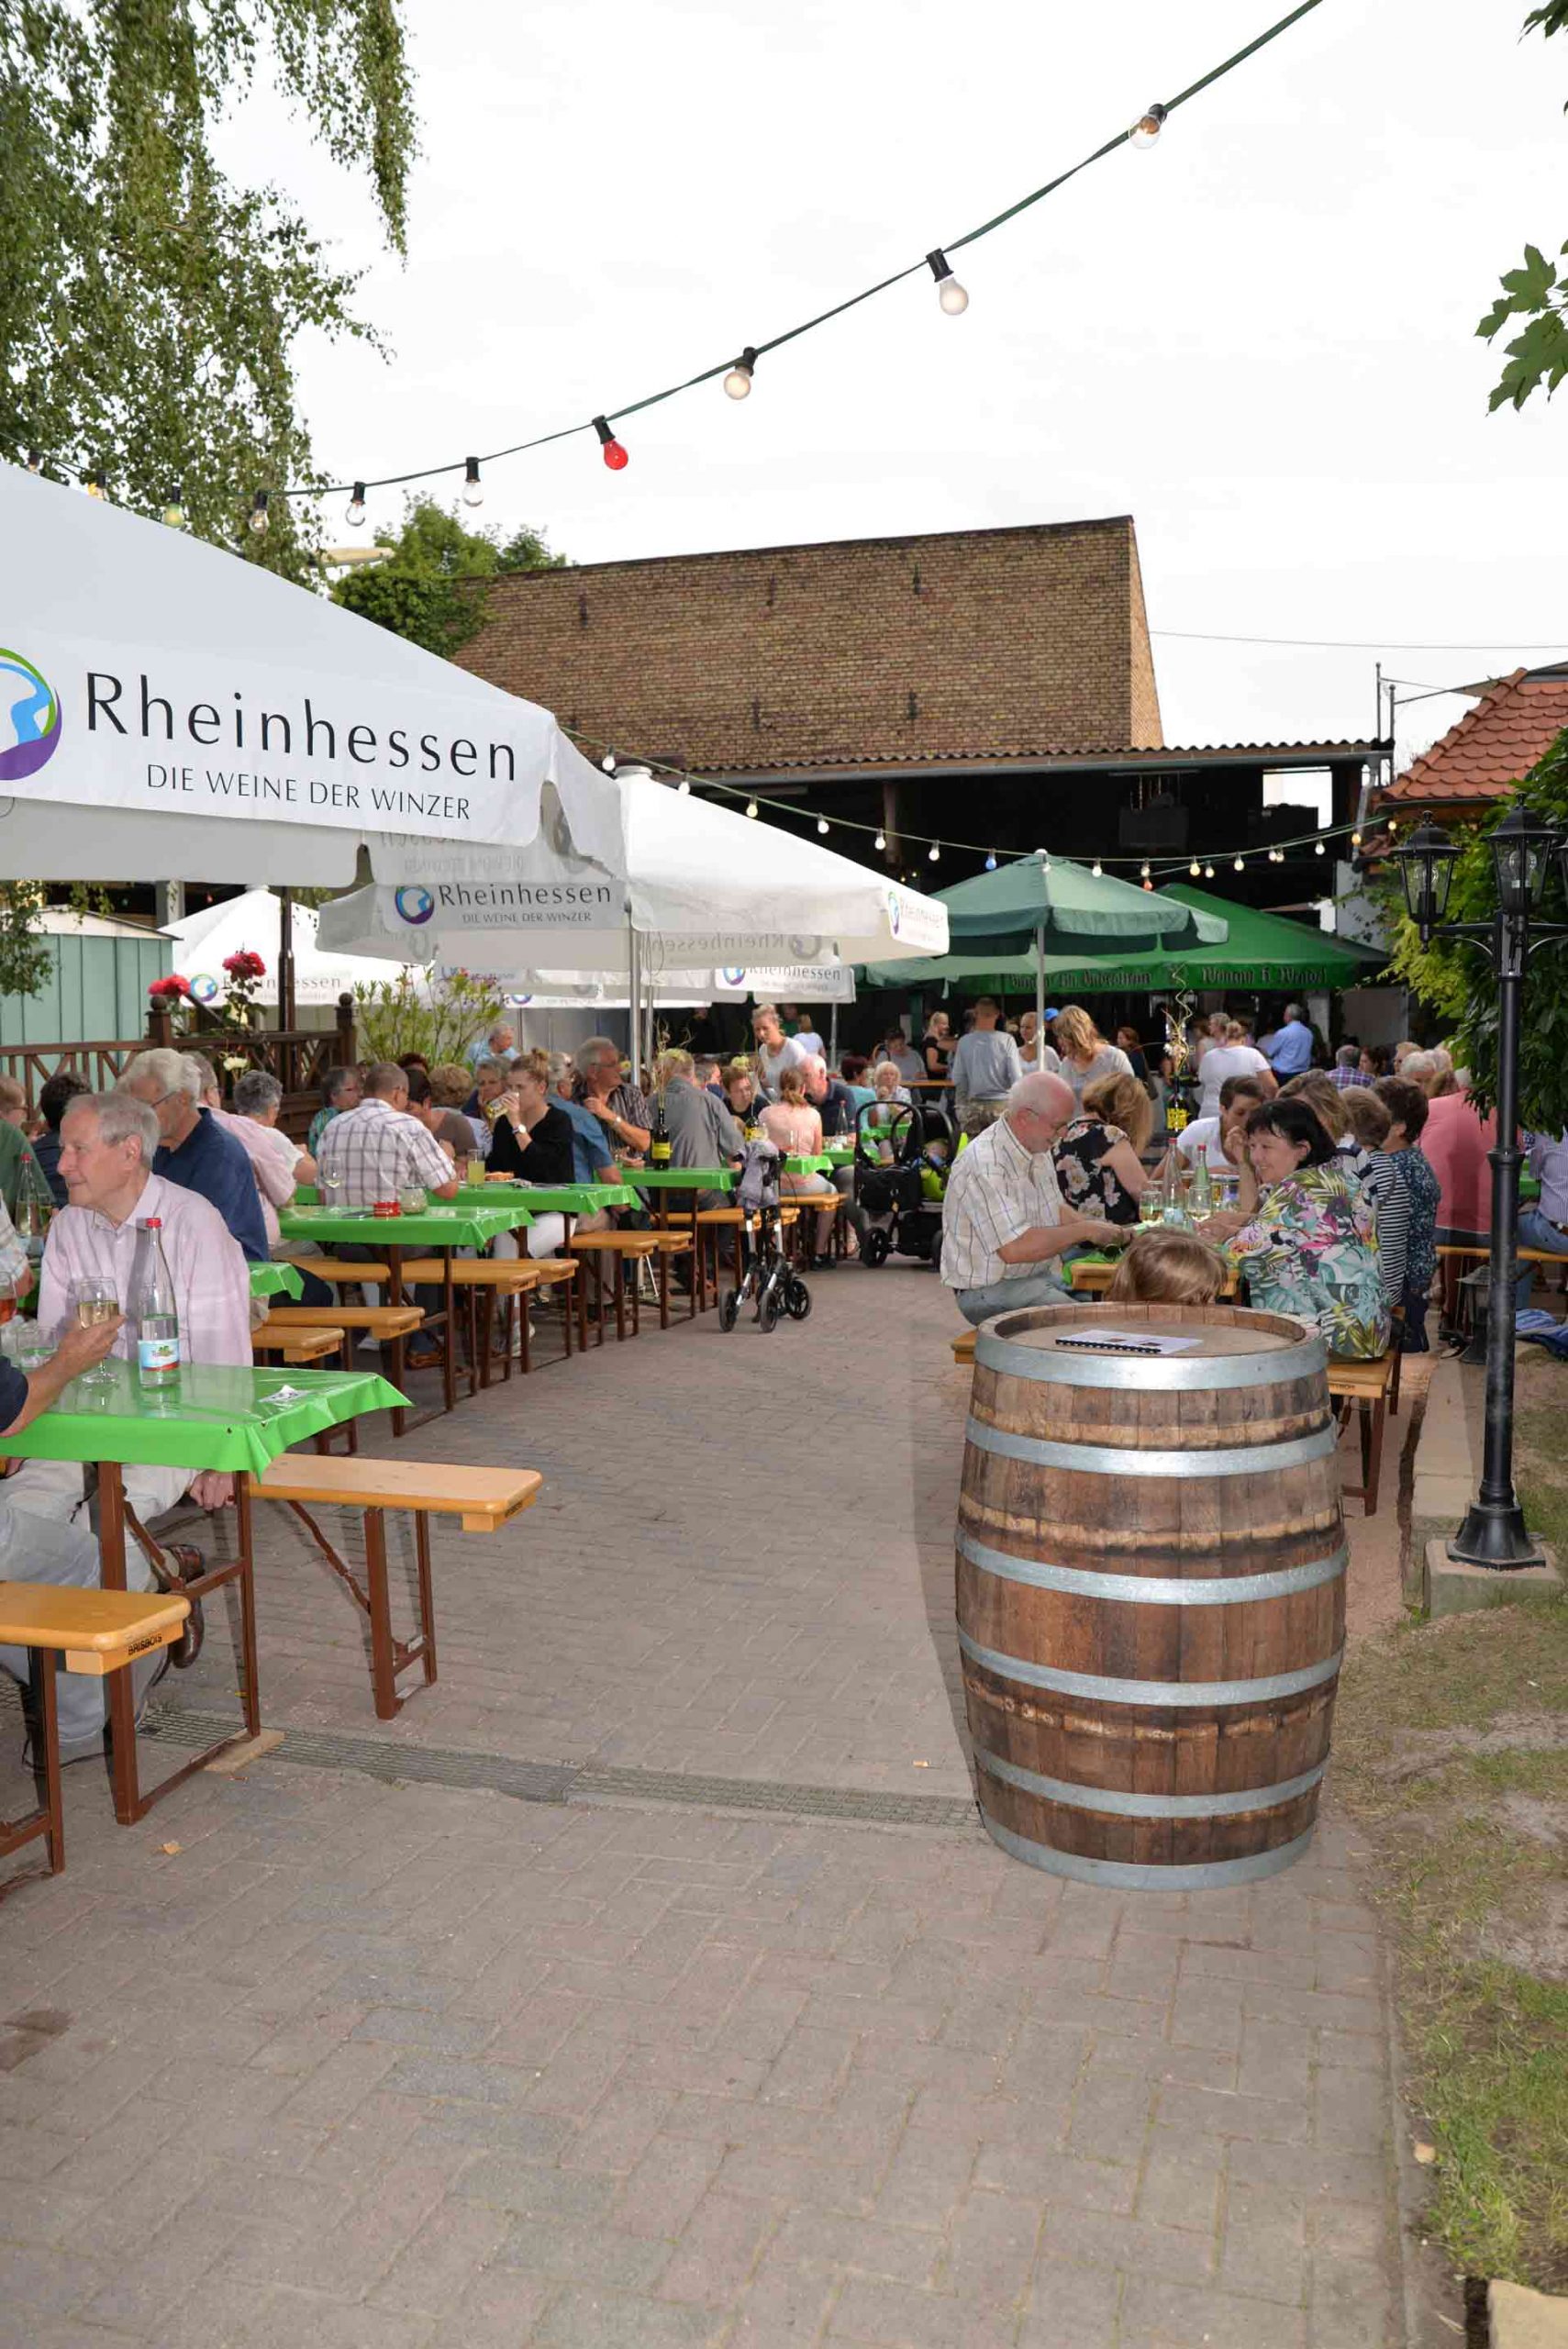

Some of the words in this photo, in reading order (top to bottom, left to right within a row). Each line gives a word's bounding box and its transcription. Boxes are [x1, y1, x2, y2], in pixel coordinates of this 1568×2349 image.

[86, 672, 516, 781] Rheinhessen
[147, 763, 195, 792] DIE
[206, 770, 298, 802] WEINE
[309, 781, 361, 809] DER
[371, 787, 471, 820] WINZER
[439, 884, 611, 907] Rheinhessen
[462, 913, 480, 924] DIE
[483, 912, 518, 923] WEINE
[522, 911, 543, 923] DER
[547, 911, 592, 922] WINZER
